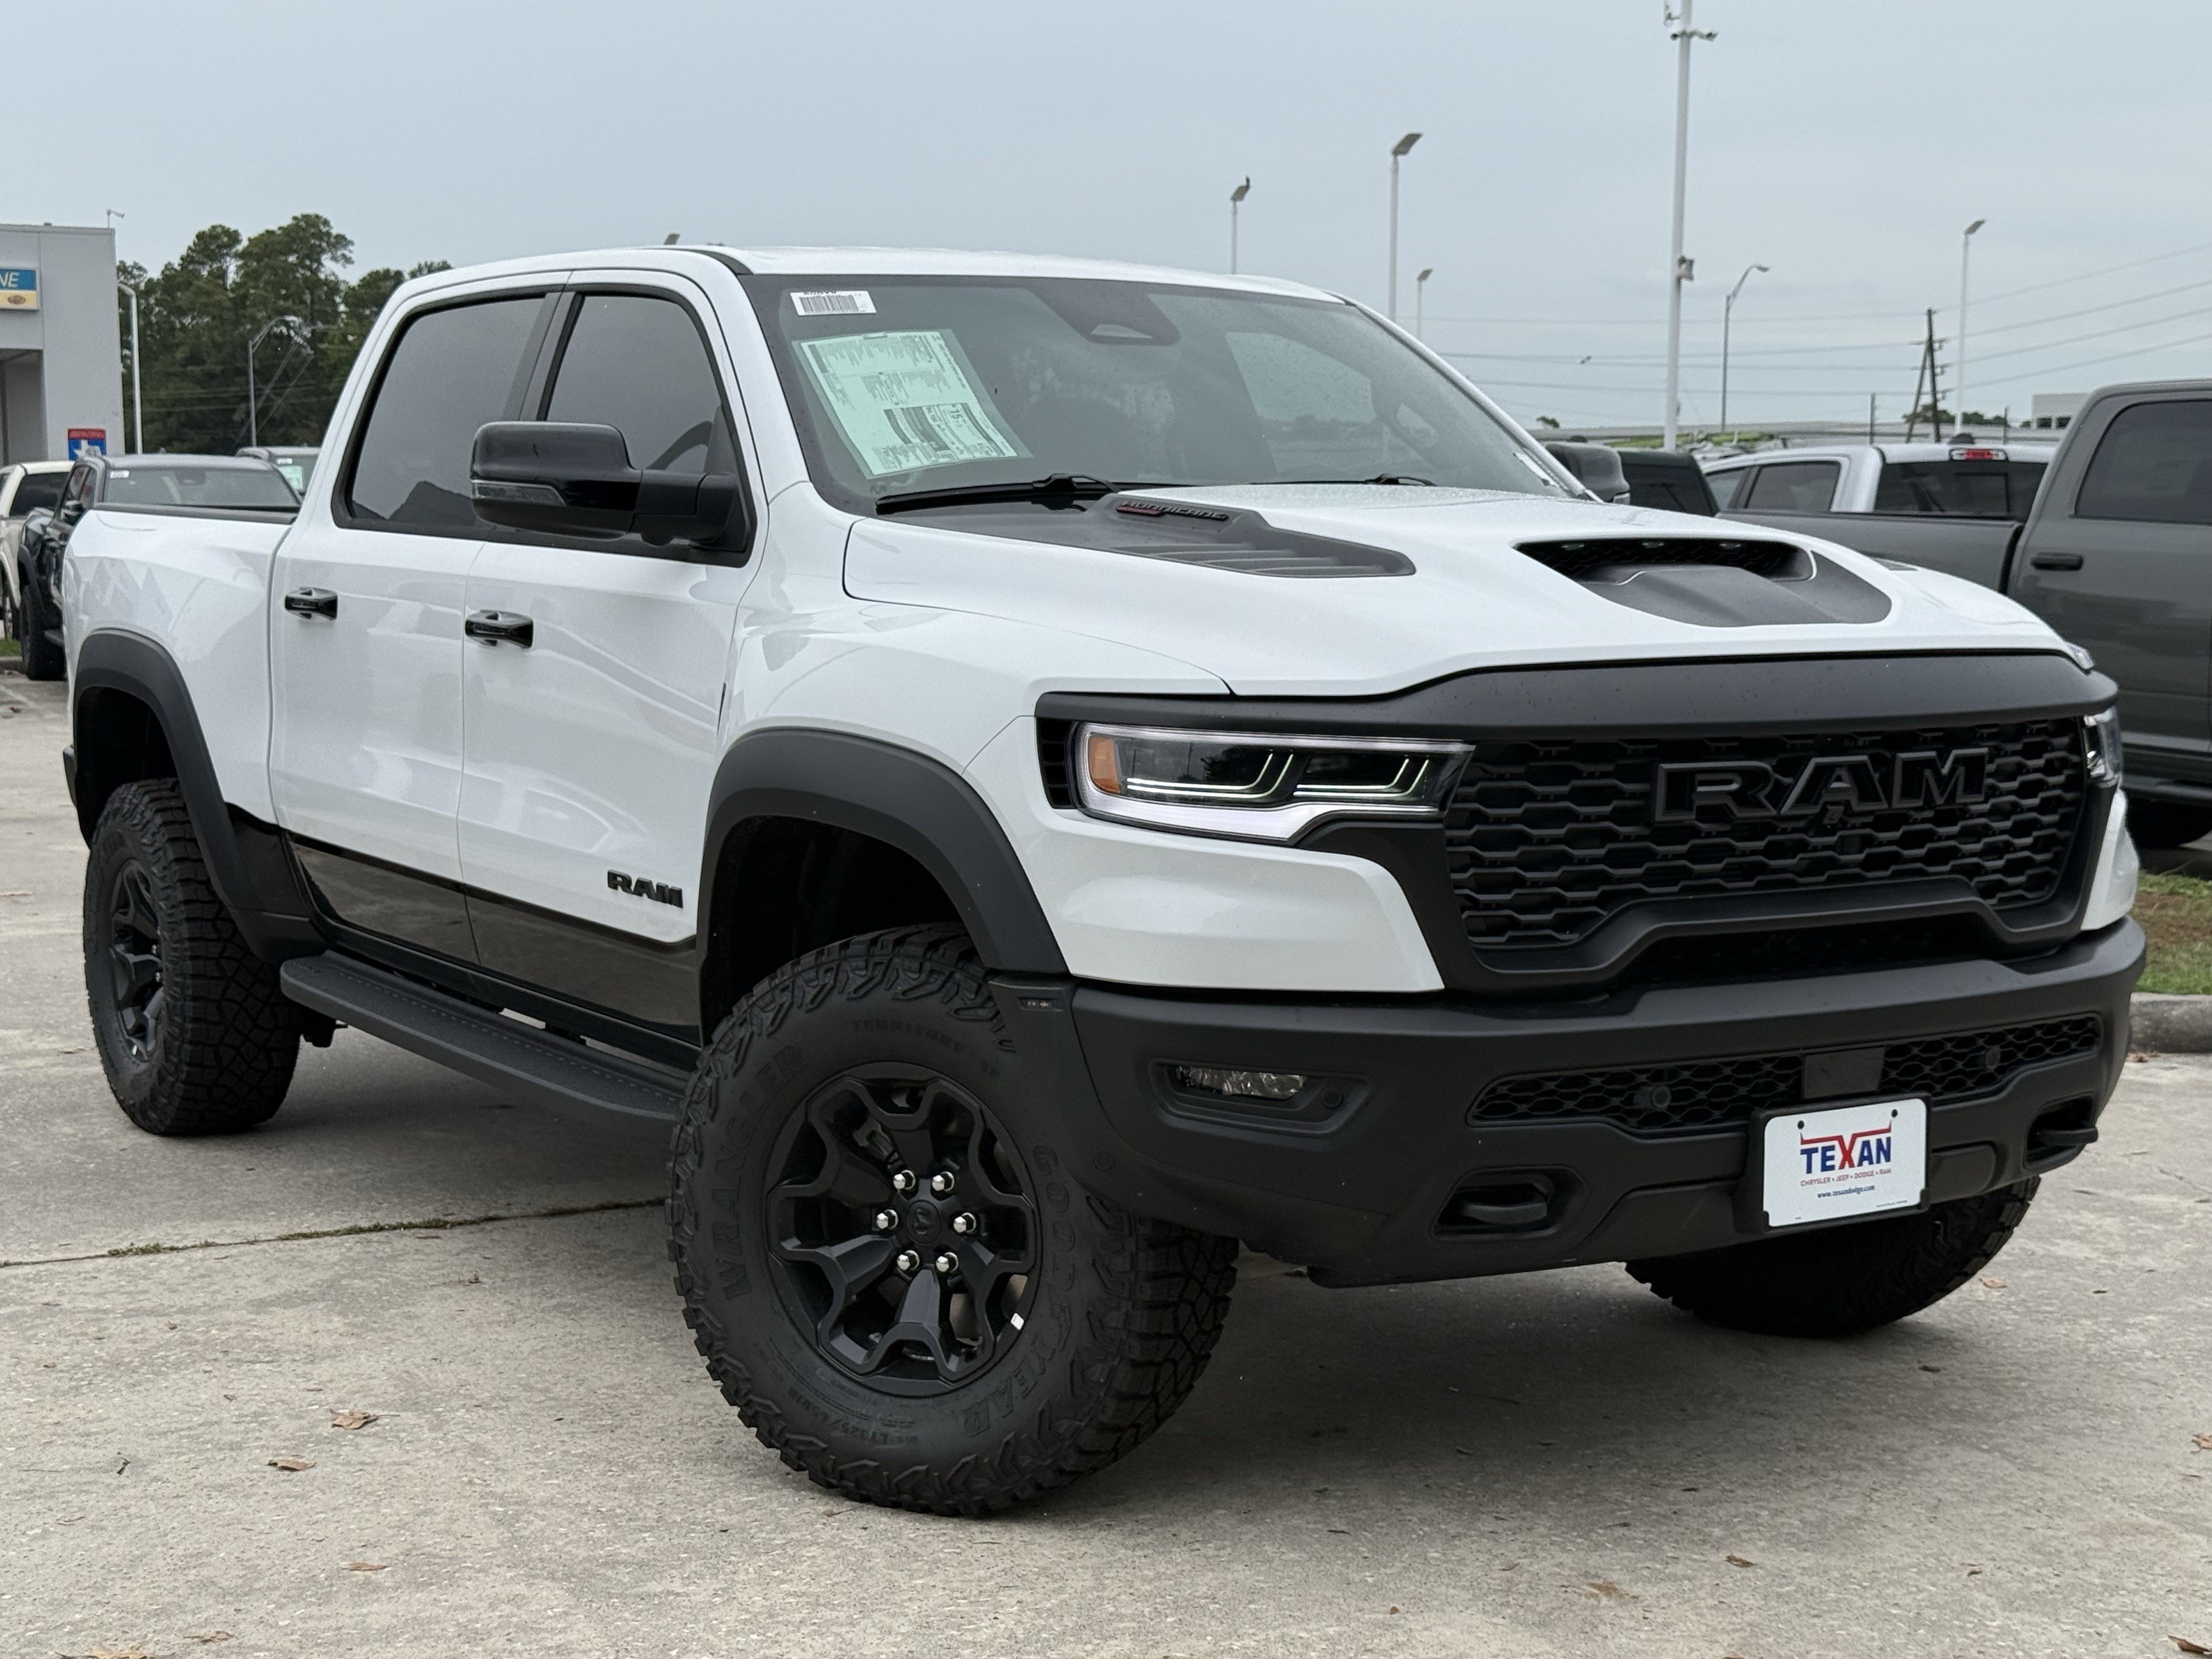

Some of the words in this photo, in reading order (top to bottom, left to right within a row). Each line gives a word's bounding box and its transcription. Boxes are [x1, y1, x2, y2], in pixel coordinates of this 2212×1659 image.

[1655, 747, 1989, 821] RAM
[607, 869, 684, 909] RAM
[712, 1043, 808, 1300] WRANGLER
[1800, 1131, 1892, 1174] TEXAN
[1800, 1176, 1831, 1187] CHRYSLER
[1835, 1174, 1849, 1182] JEEP
[1854, 1170, 1875, 1180] DODGE
[962, 1142, 1075, 1438] GOODYEAR
